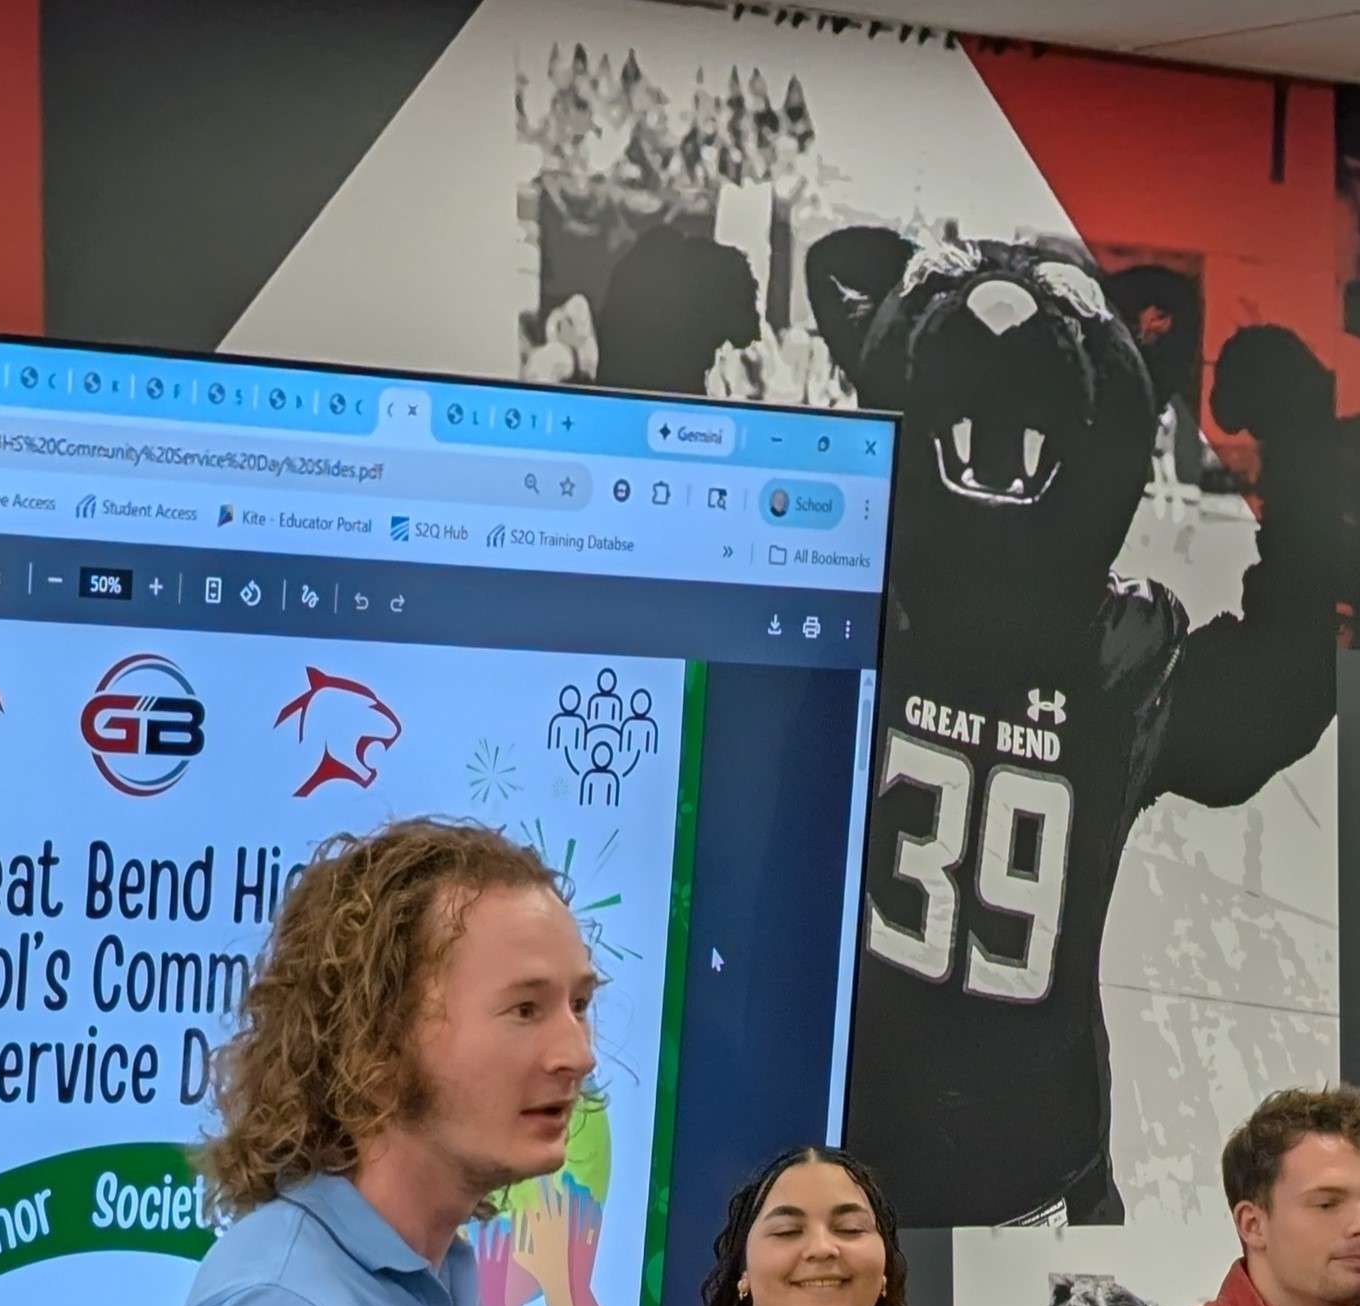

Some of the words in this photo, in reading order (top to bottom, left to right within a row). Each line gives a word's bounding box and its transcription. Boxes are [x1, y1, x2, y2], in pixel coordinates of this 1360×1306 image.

[677, 425, 723, 445] Gemini
[13, 493, 57, 511] Access
[102, 500, 151, 518] Student
[153, 503, 198, 521] Access
[795, 495, 834, 513] School
[242, 511, 267, 527] Kite
[279, 514, 333, 532] Educator
[337, 516, 373, 534] Portal
[414, 522, 441, 541] S2Q
[443, 524, 469, 541] Hub
[510, 529, 536, 548] S2Q
[539, 531, 584, 552] Training
[587, 534, 635, 553] Databse
[793, 549, 809, 565] All
[811, 549, 871, 569] Bookmarks
[89, 574, 122, 594] 50%
[904, 695, 986, 746] GREAT
[996, 720, 1061, 763] BEND
[865, 726, 1075, 1004] 39
[85, 840, 214, 922] Bend
[233, 845, 304, 924] Hi
[92, 933, 250, 1016] Comm
[180, 1028, 210, 1103] D
[91, 1170, 230, 1237] Societ
